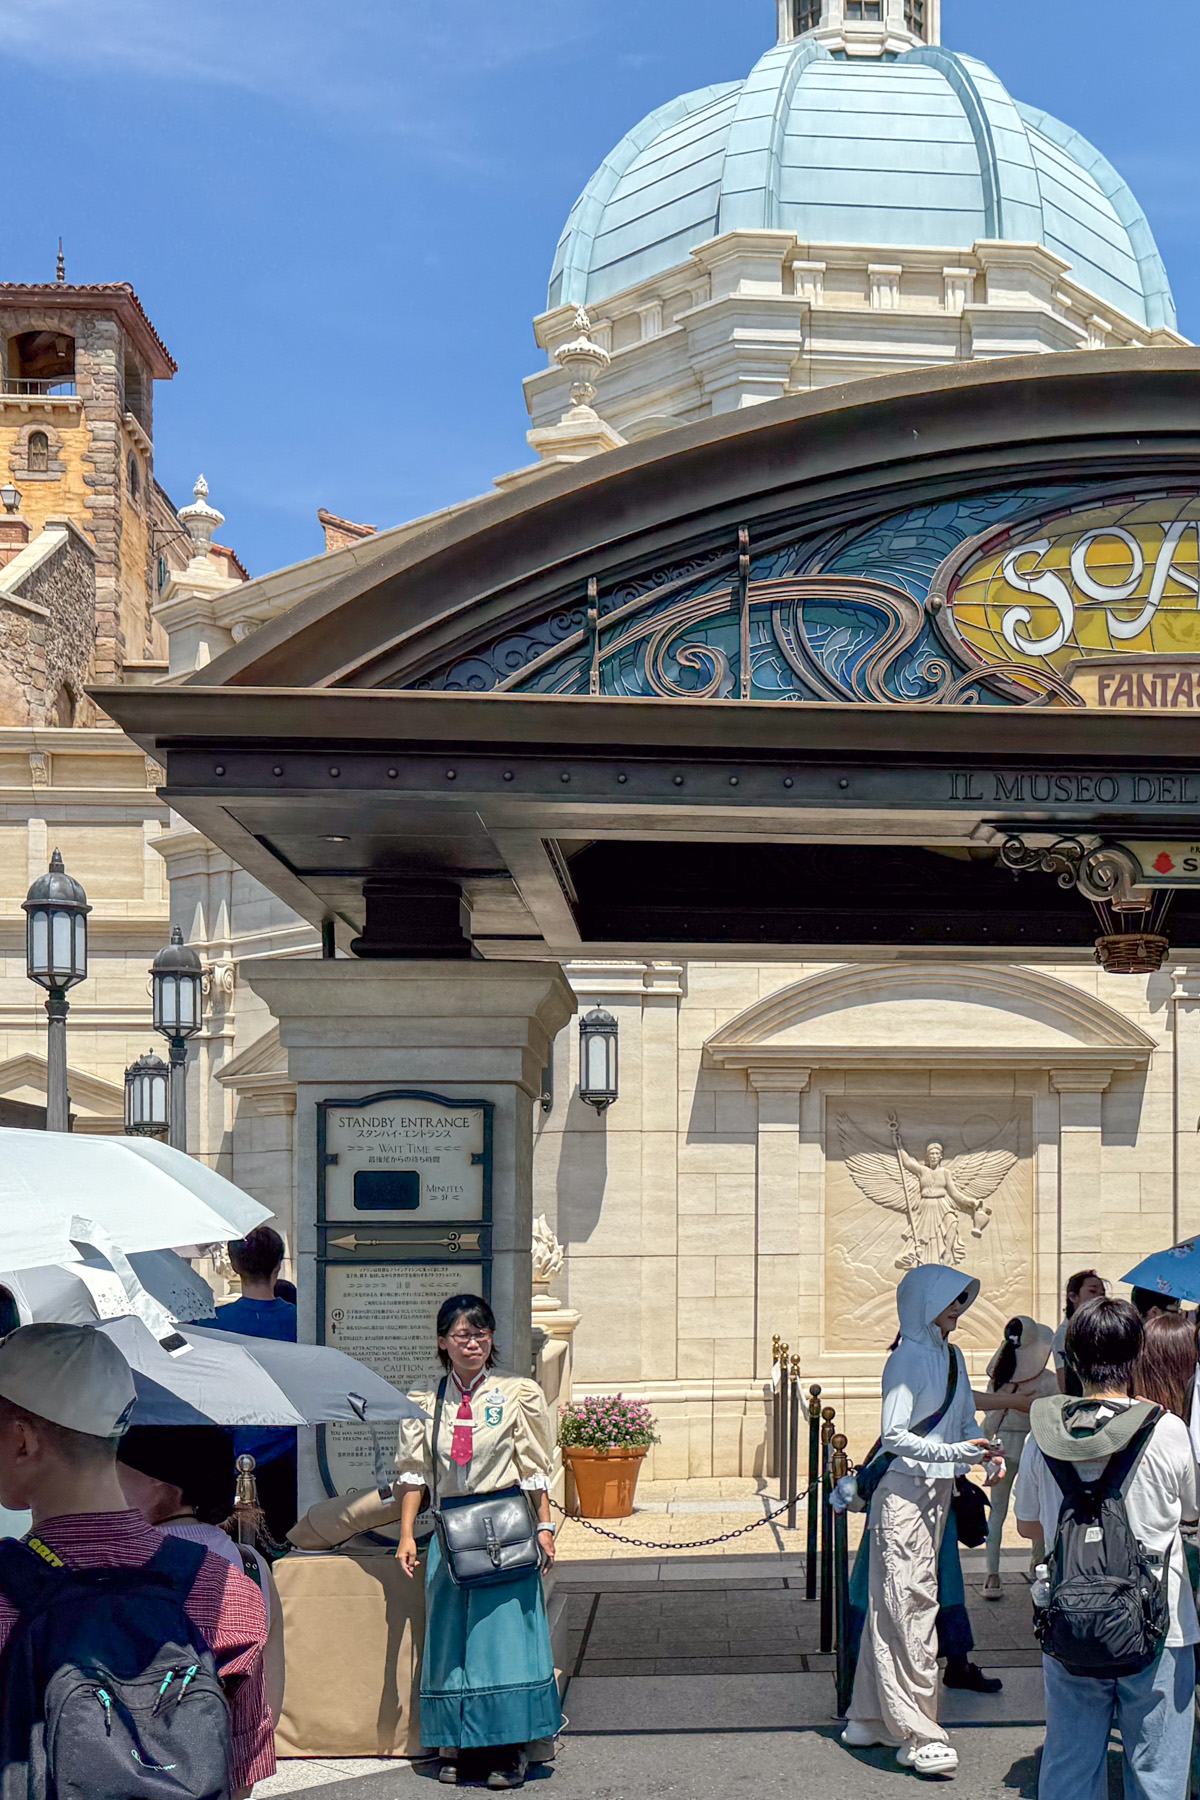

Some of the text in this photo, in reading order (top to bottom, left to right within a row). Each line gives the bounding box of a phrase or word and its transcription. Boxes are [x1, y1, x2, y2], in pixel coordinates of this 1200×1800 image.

[948, 773, 983, 800] IL
[993, 774, 1120, 803] MUSEO
[1130, 775, 1198, 803] DEL
[338, 1117, 470, 1128] STANDBY ENTRANCE
[383, 1364, 424, 1372] CAUTION
